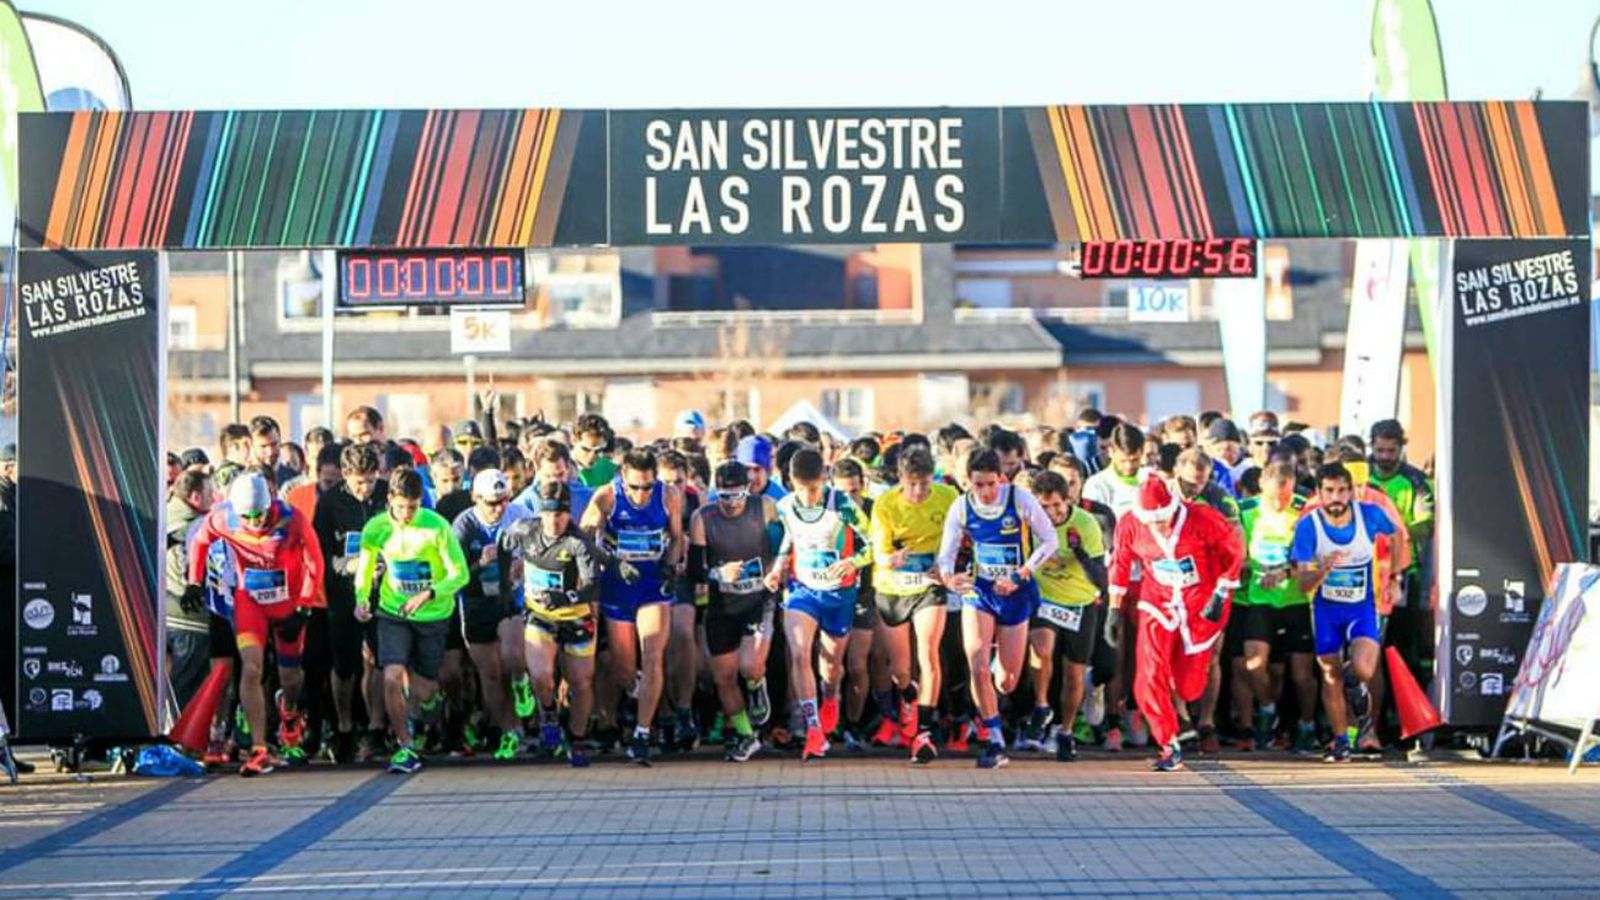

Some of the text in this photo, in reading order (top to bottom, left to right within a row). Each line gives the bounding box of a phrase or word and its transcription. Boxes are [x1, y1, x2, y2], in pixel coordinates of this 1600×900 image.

[645, 118, 963, 171] SAN SILVESTRE
[645, 175, 965, 234] LAS ROZAS
[21, 262, 140, 304] SAN SILVESTRE
[349, 256, 513, 297] 00:00:00
[1456, 250, 1575, 292] SAN SILVESTRE
[1460, 271, 1579, 315] LAS ROZAS
[25, 283, 144, 328] LAS ROZAS
